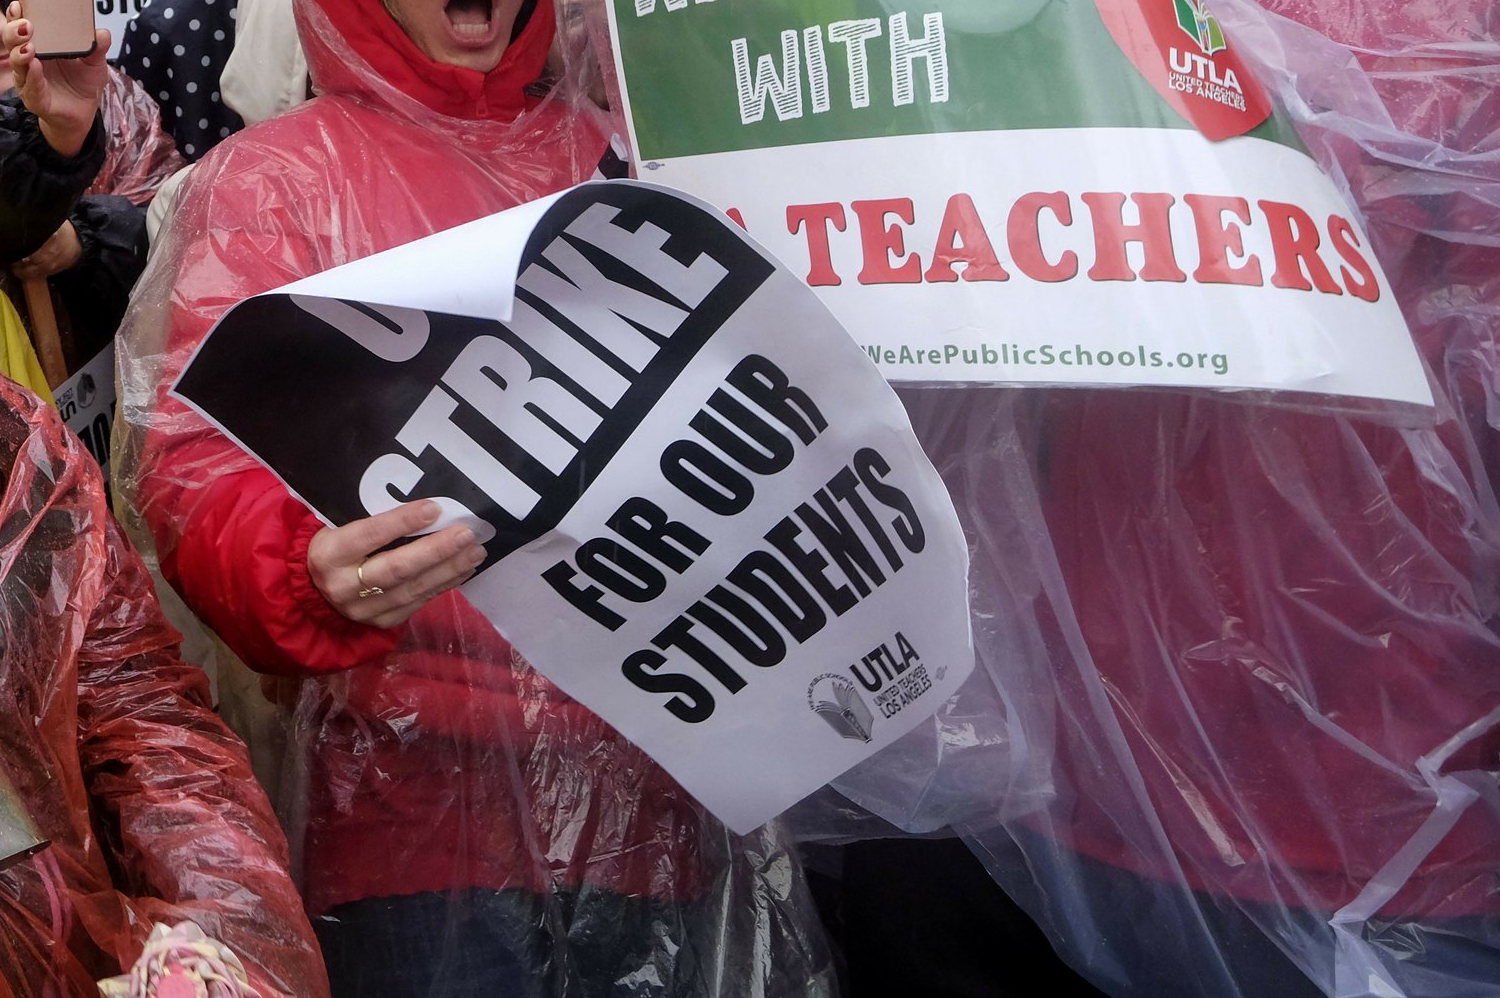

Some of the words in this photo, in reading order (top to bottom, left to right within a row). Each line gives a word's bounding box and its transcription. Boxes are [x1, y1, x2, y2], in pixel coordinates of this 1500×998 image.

[731, 11, 950, 125] WITH
[1169, 47, 1243, 94] UTLA
[1169, 71, 1202, 87] UNITED
[1169, 79, 1193, 94] LOS
[1196, 89, 1248, 112] ANGELES
[786, 190, 1383, 305] TEACHERS
[358, 201, 732, 547] STRIKE
[539, 495, 711, 633] FOR
[658, 353, 829, 517] OUR
[620, 446, 926, 724] STUDENTS
[849, 631, 920, 692] UTLA
[873, 685, 901, 706] UNITED
[897, 663, 927, 690] TEACHERS
[880, 698, 902, 719] LOS
[902, 673, 933, 709] ANGELES
